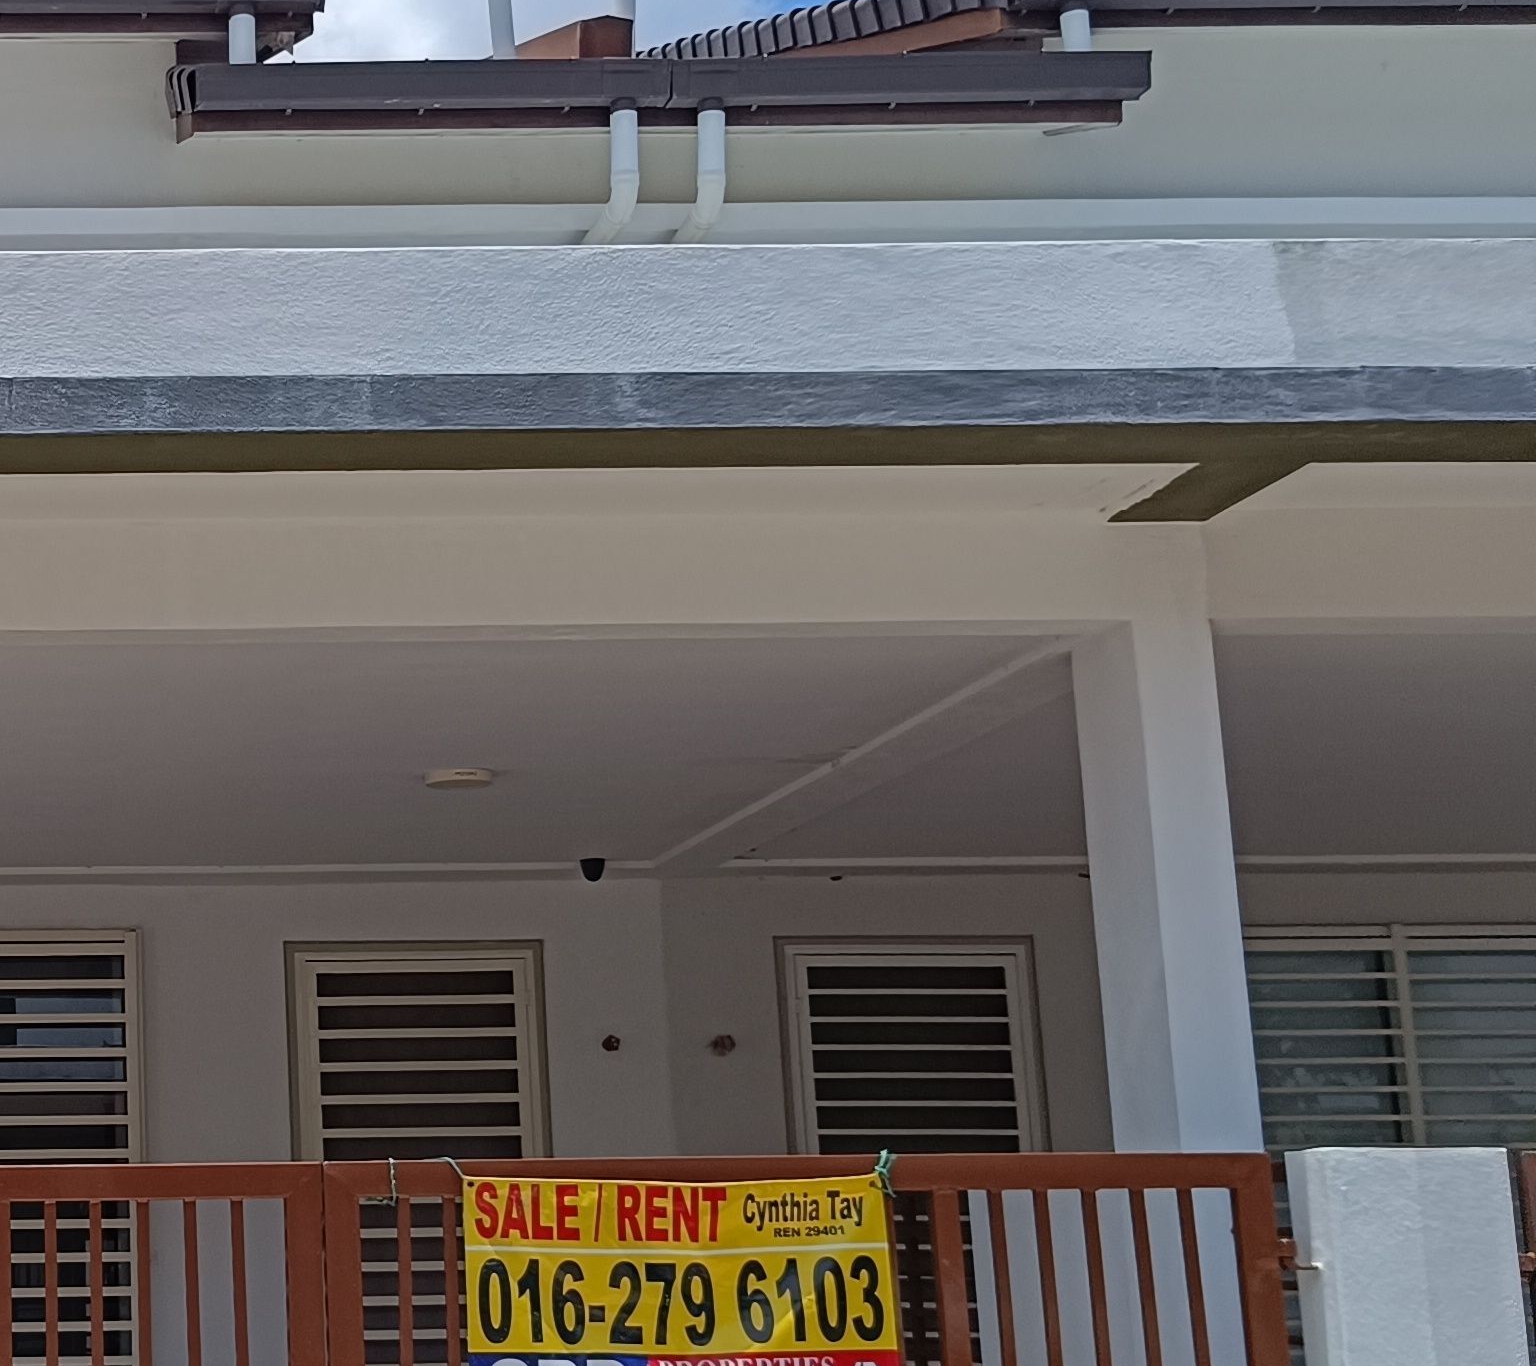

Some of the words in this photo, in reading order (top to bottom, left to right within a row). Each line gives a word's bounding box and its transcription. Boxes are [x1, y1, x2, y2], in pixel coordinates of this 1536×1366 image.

[474, 1182, 580, 1240] SALE
[616, 1186, 727, 1243] RENT
[743, 1192, 820, 1232] Cynthia
[826, 1190, 864, 1226] Tay
[773, 1227, 801, 1237] REN
[805, 1225, 845, 1236] 29401
[479, 1259, 716, 1346] 016-279
[737, 1254, 884, 1343] 6103
